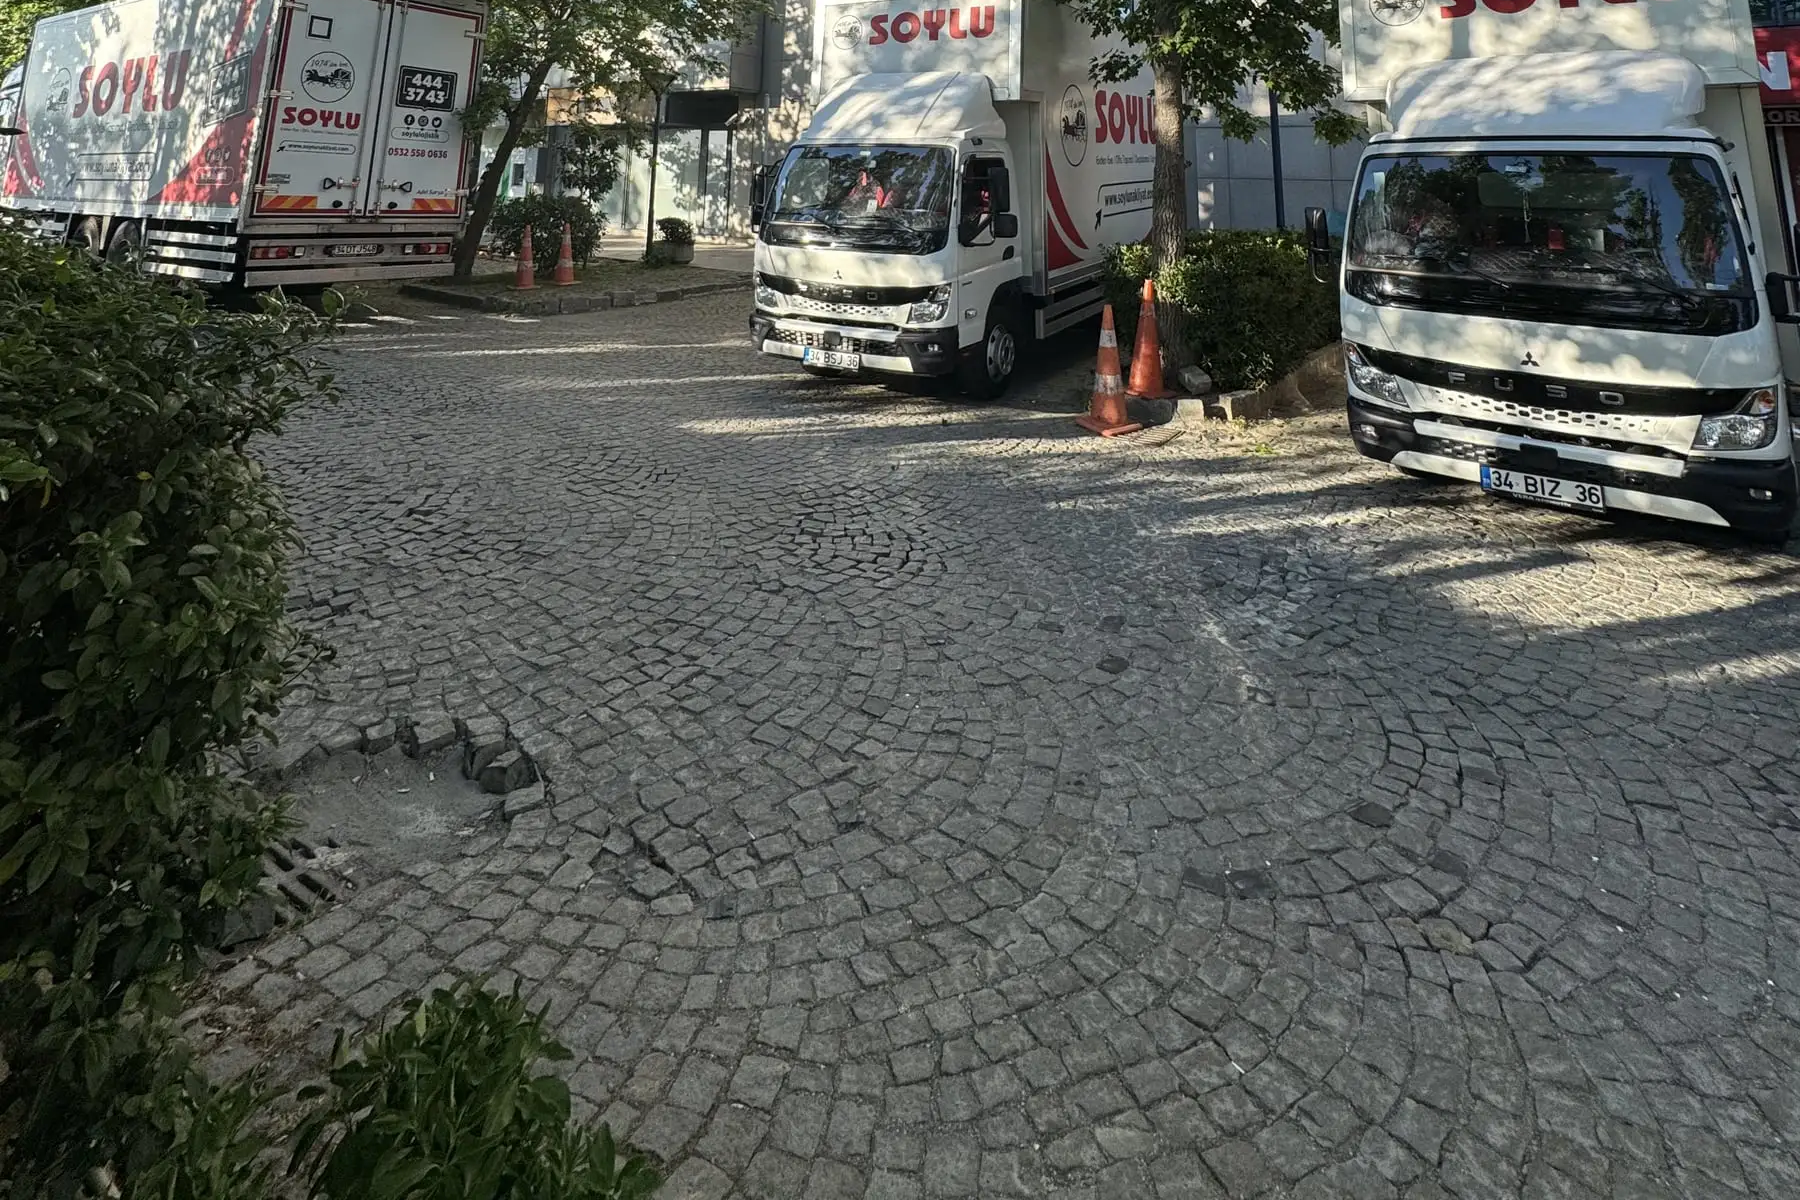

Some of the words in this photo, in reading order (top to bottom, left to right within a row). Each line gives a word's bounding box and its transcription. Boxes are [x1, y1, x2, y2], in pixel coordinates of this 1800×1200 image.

[869, 5, 995, 46] SOYLU
[72, 50, 192, 119] SOYLU
[411, 73, 443, 89] 444
[405, 87, 446, 104] 3743
[282, 106, 361, 130] SOYLU
[388, 147, 409, 157] 0532
[810, 350, 820, 361] 34
[823, 351, 843, 366] BSJ
[846, 355, 858, 368] 36
[1447, 371, 1625, 406] FUSO
[1491, 470, 1513, 490] 34
[1524, 475, 1562, 499] BIZ
[1575, 484, 1601, 505] 36
